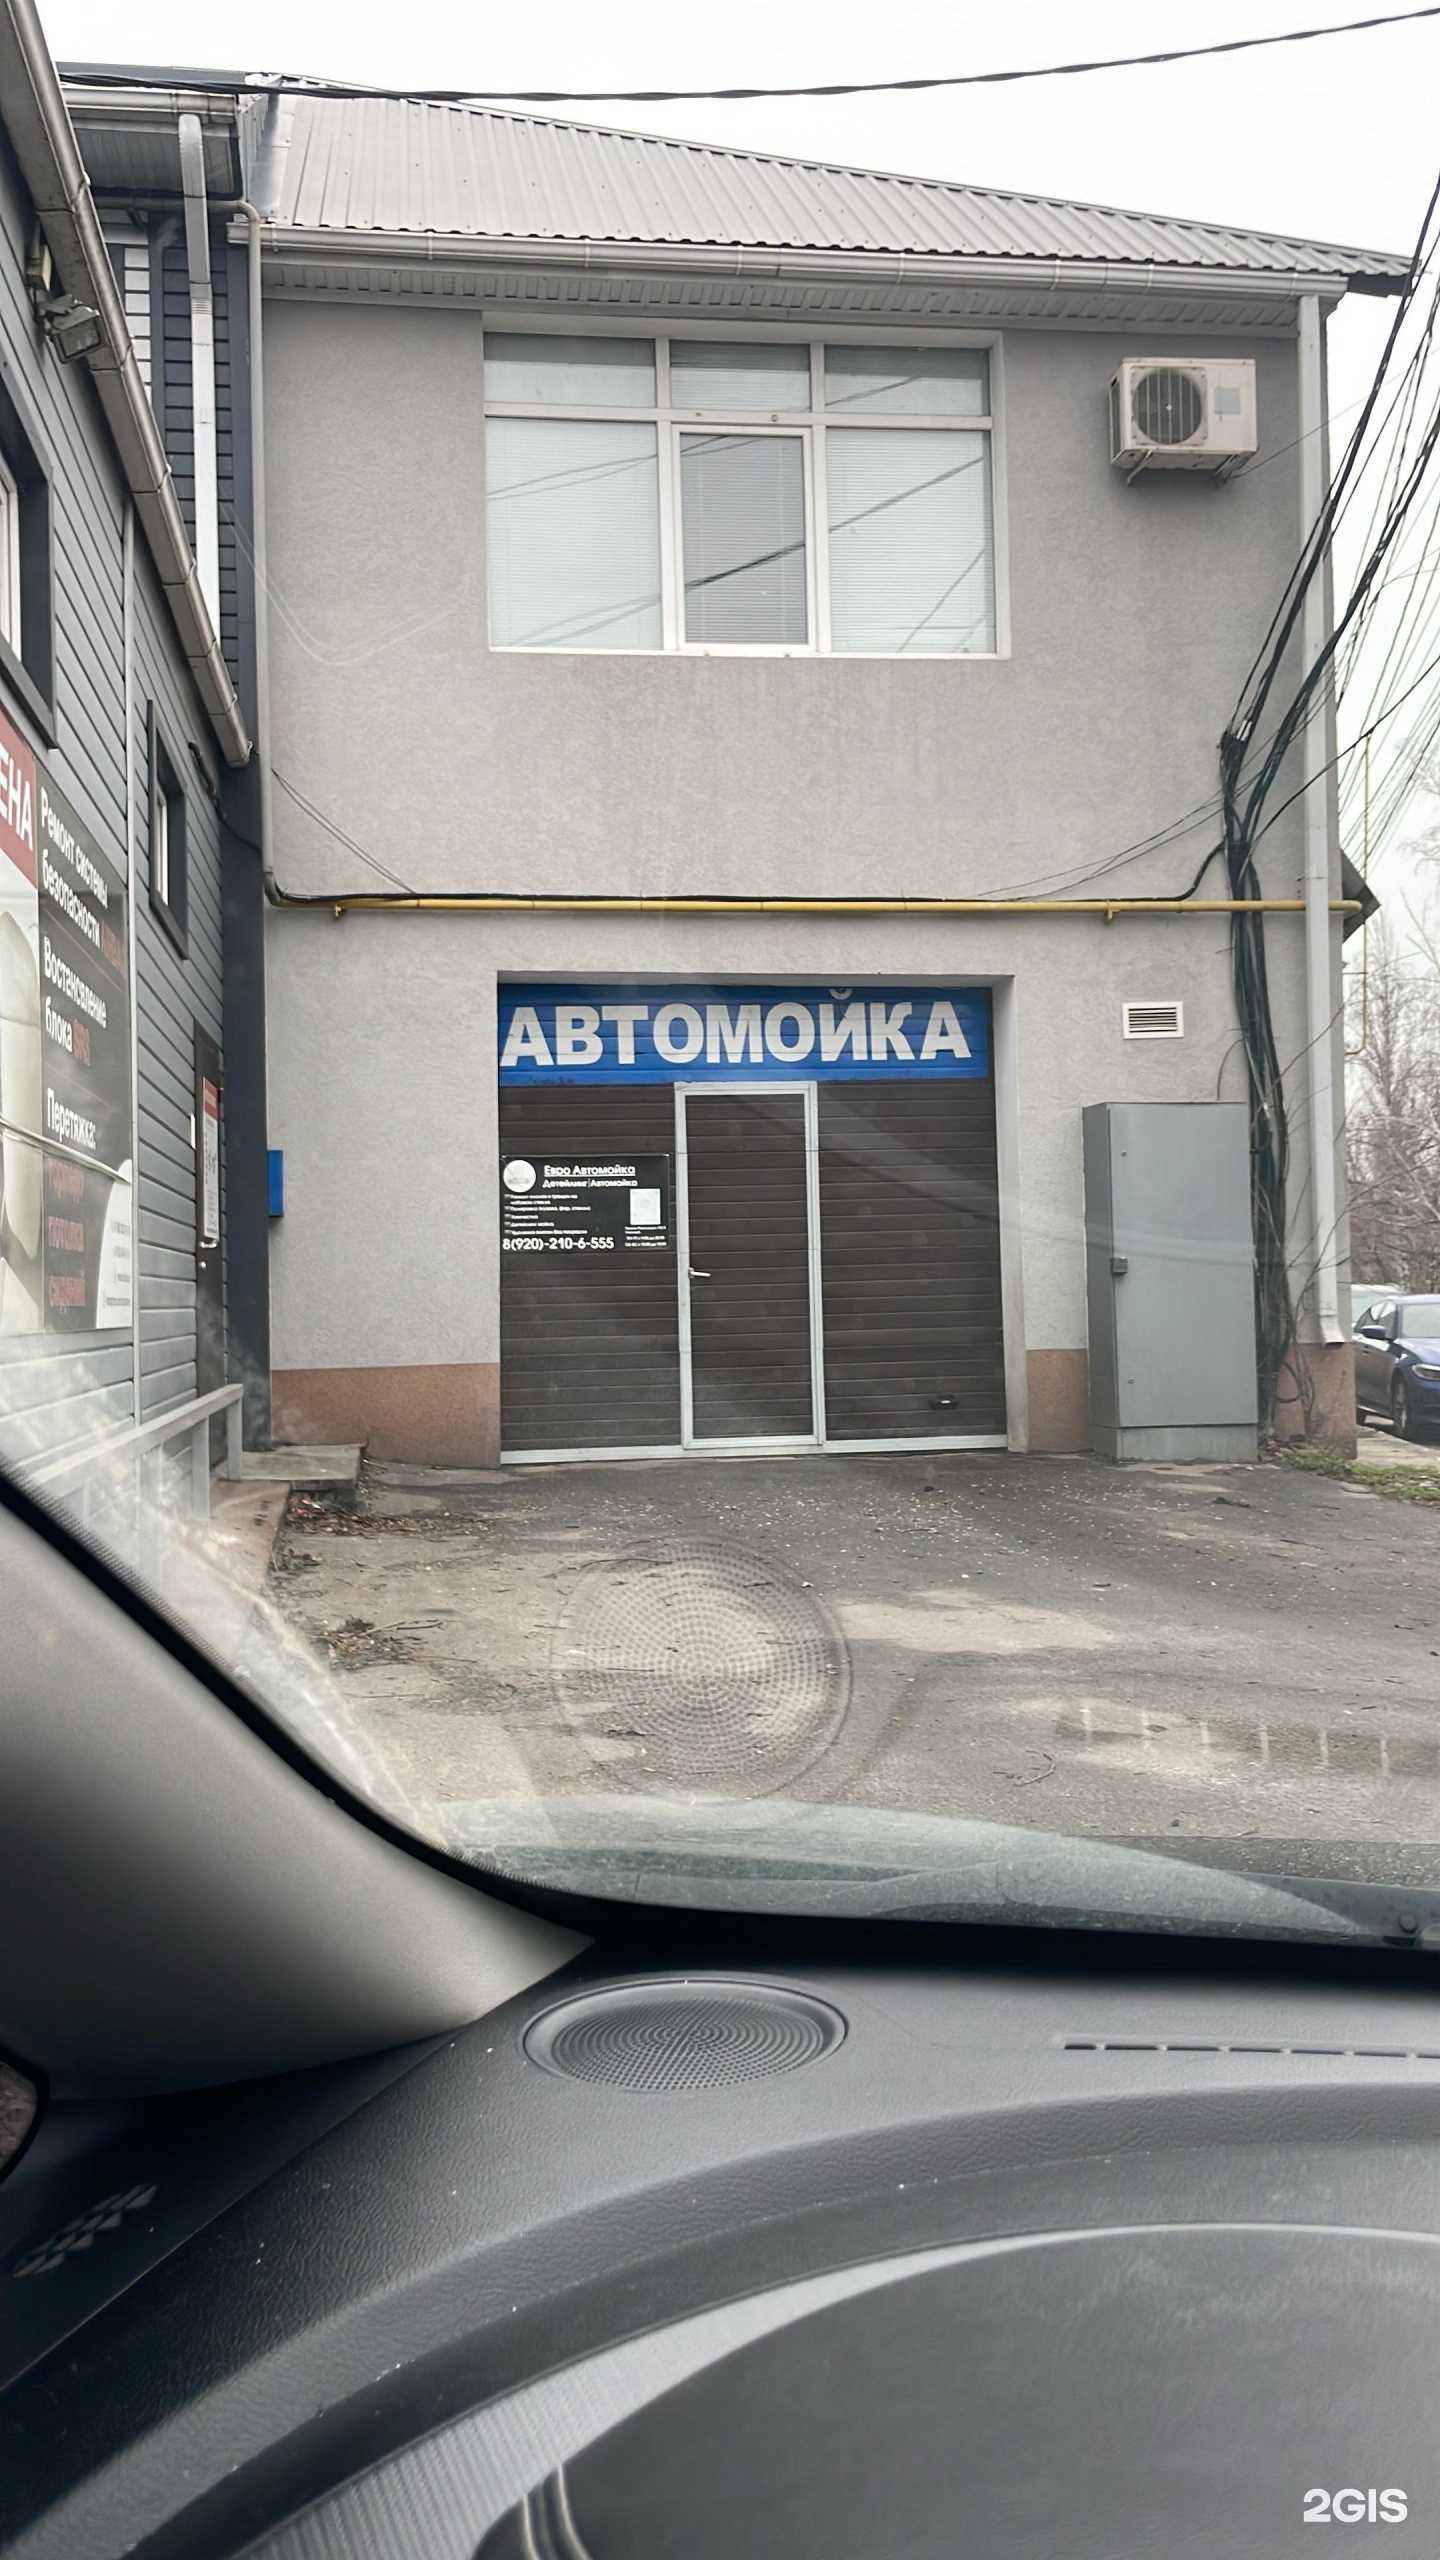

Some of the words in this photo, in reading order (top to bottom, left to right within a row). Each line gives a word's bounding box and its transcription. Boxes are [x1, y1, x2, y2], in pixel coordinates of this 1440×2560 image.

[41, 787, 75, 865] Ремонт
[76, 845, 108, 909] системы
[42, 849, 100, 949] безопасности
[46, 996, 73, 1053] блока
[500, 988, 972, 1066] АВТОМОЙКА
[544, 1165, 570, 1175] Евро
[572, 1164, 636, 1176] Автомойка
[502, 1237, 615, 1251] 8(920)-210-6-555
